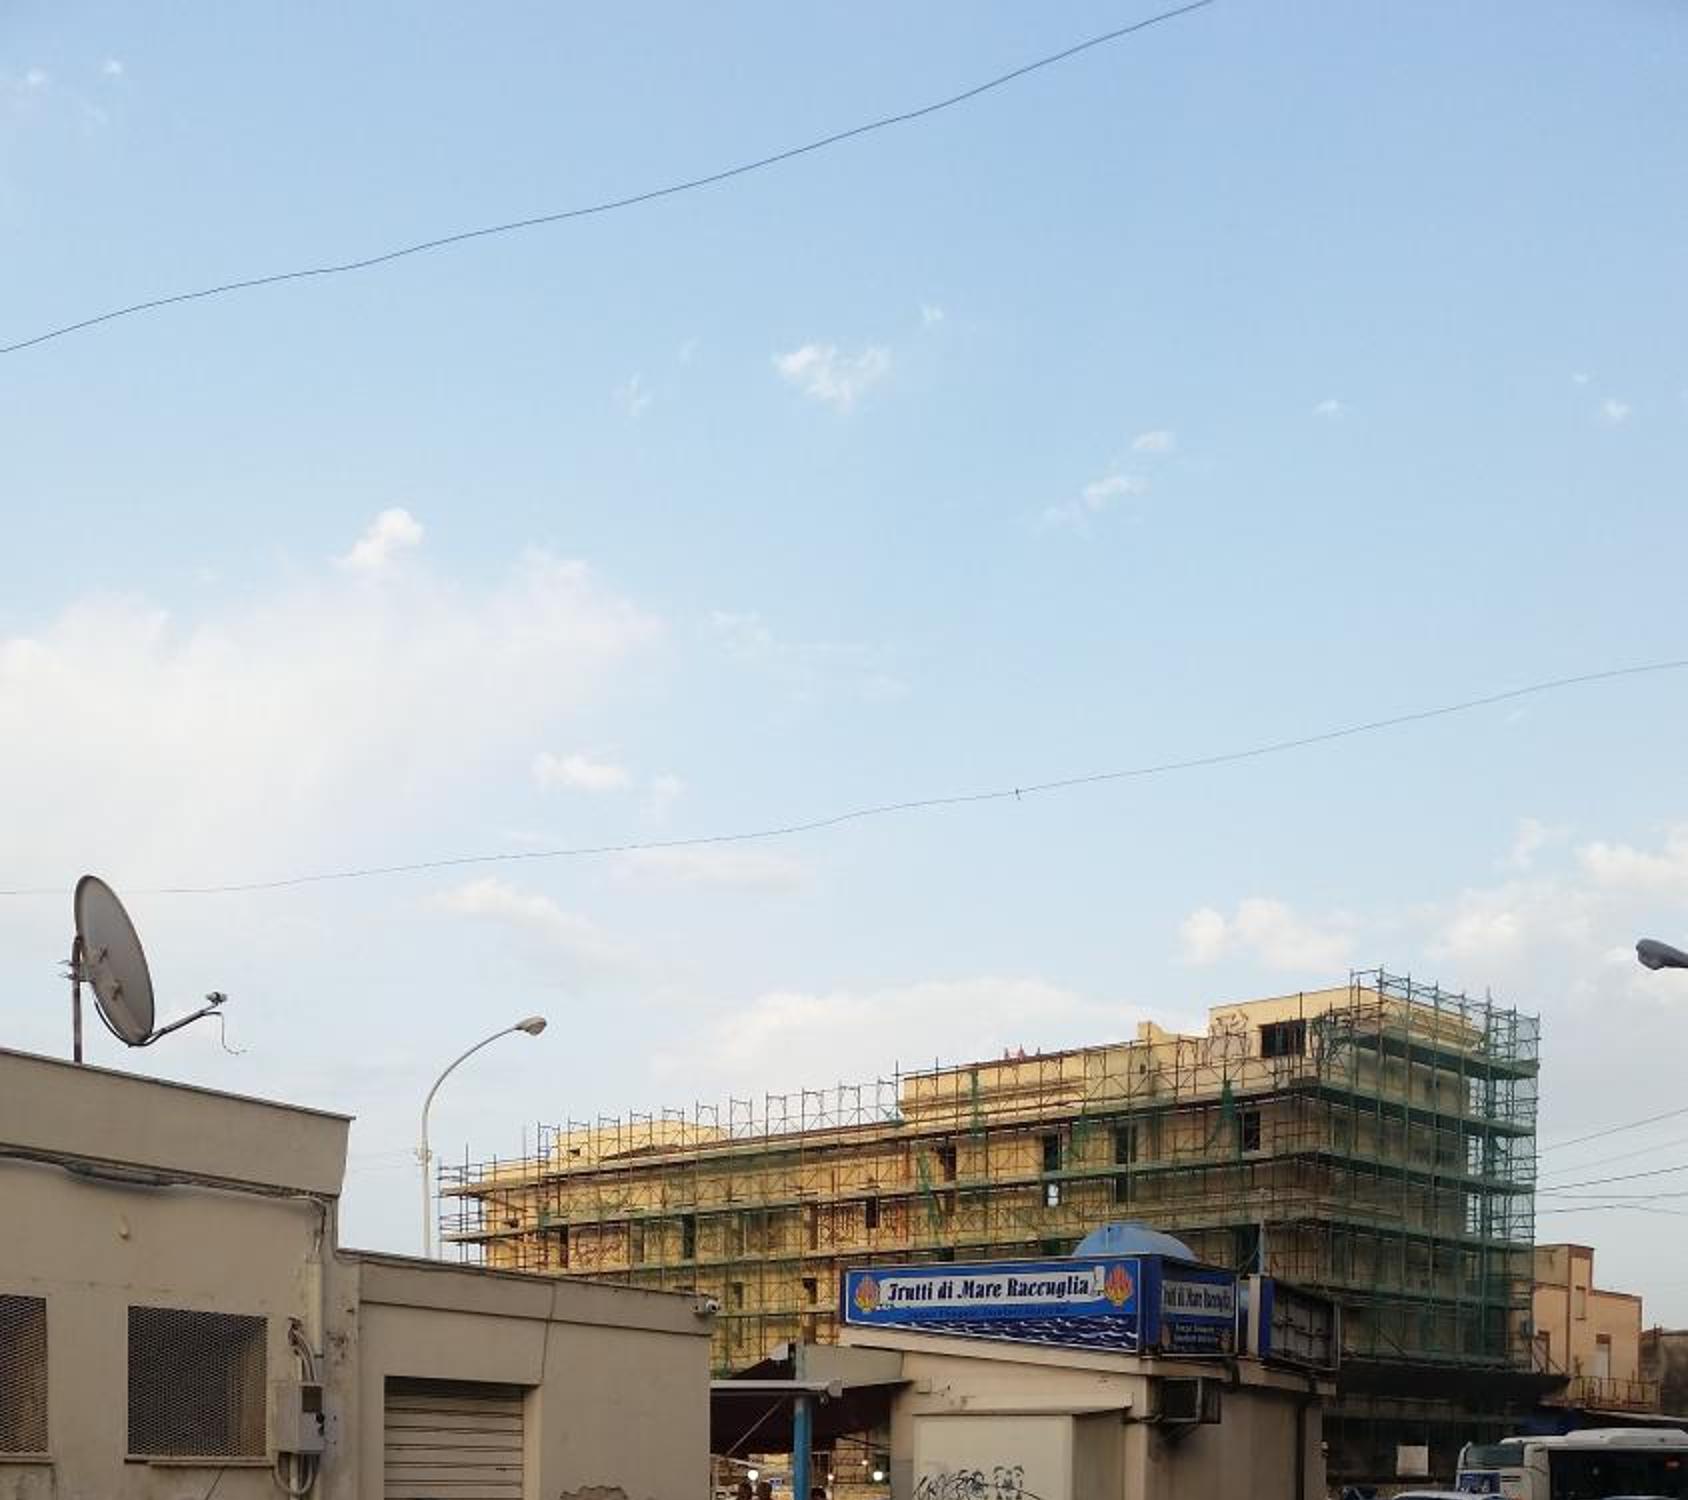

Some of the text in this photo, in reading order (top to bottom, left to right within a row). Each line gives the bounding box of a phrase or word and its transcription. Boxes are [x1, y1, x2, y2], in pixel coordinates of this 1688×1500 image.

[937, 1280, 953, 1299] di
[957, 1278, 1002, 1300] Mare
[1006, 1275, 1090, 1299] Raccuglia
